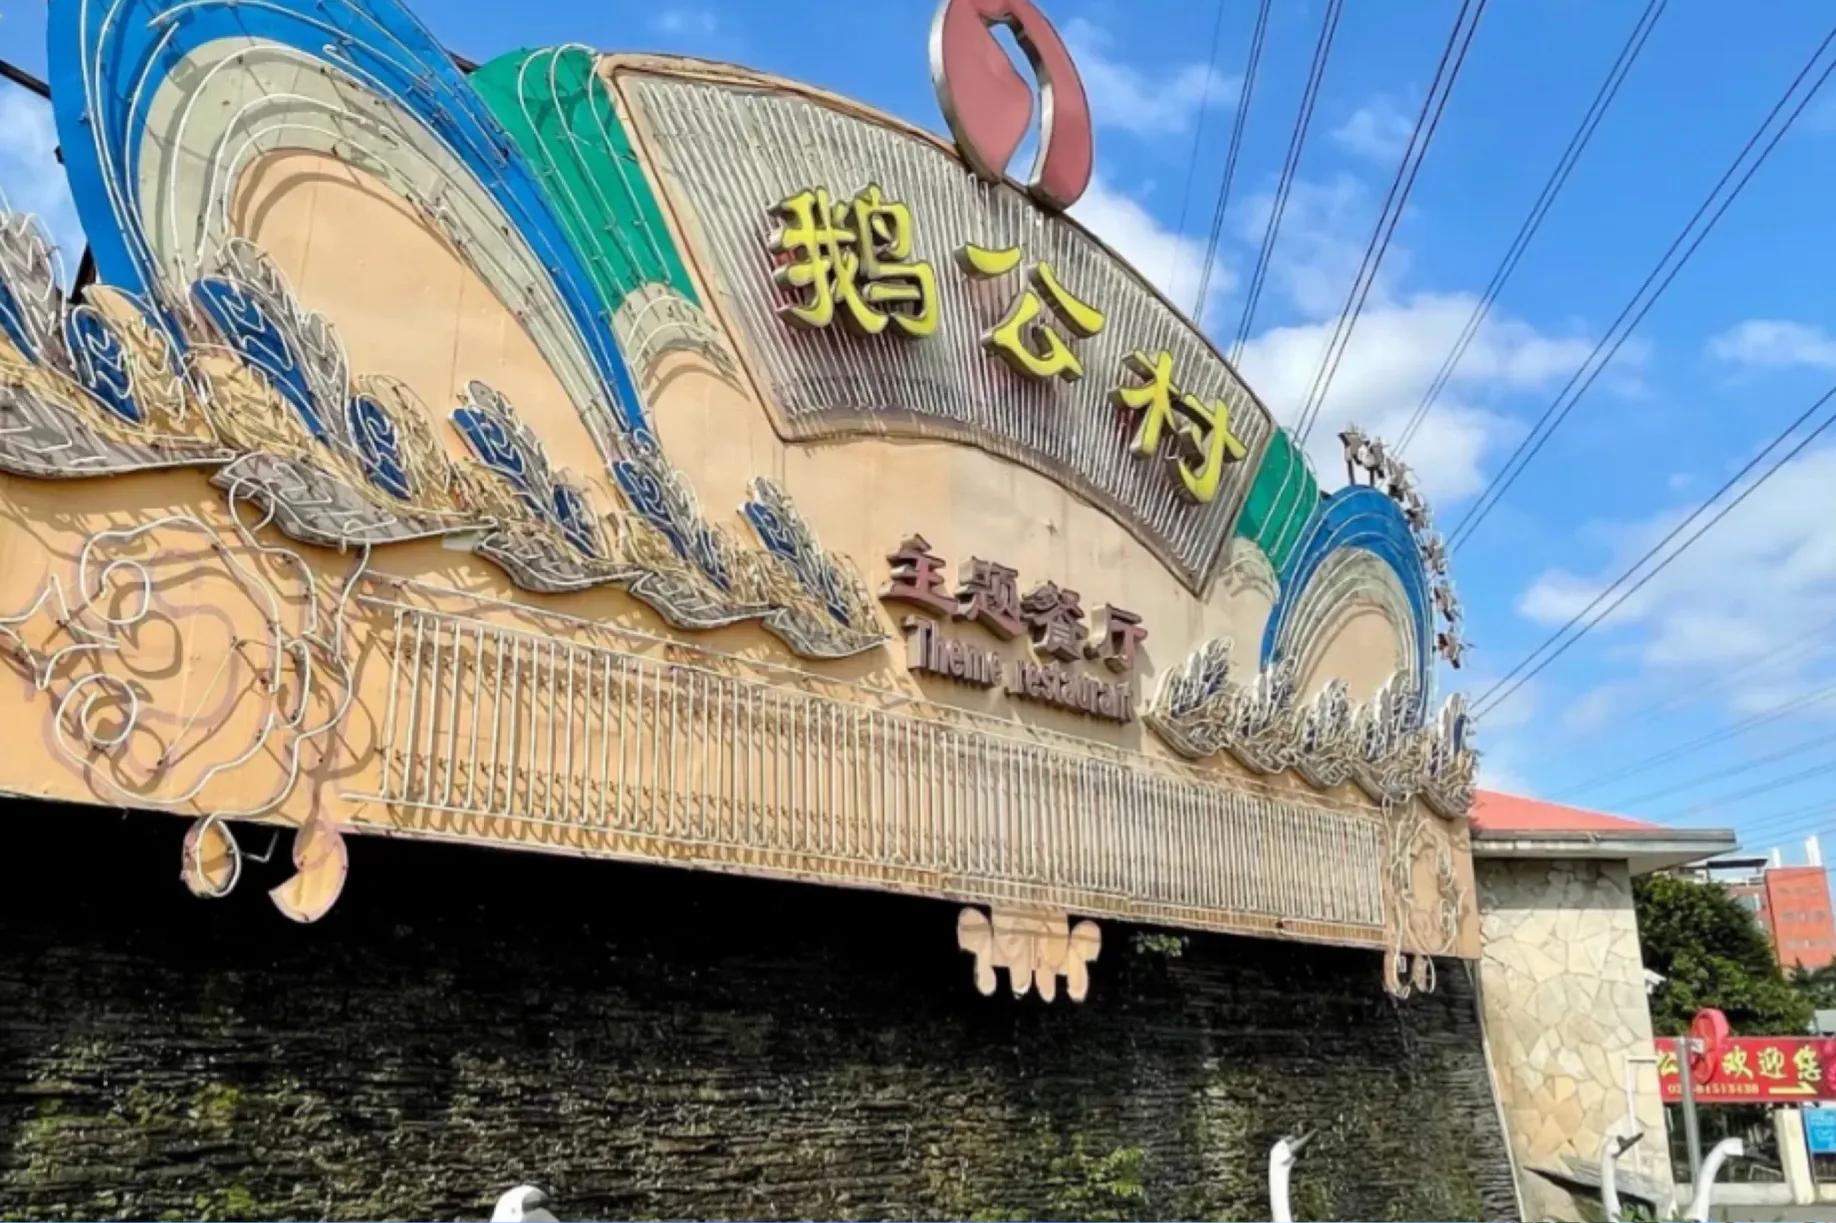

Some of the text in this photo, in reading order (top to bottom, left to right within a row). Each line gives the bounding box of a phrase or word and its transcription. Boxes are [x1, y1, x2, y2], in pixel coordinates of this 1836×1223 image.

[769, 182, 1247, 502] 鹅公村
[880, 533, 1148, 672] 主题餐厅
[904, 616, 1000, 686] Theme
[1657, 1045, 1822, 1081] 公欢迎您
